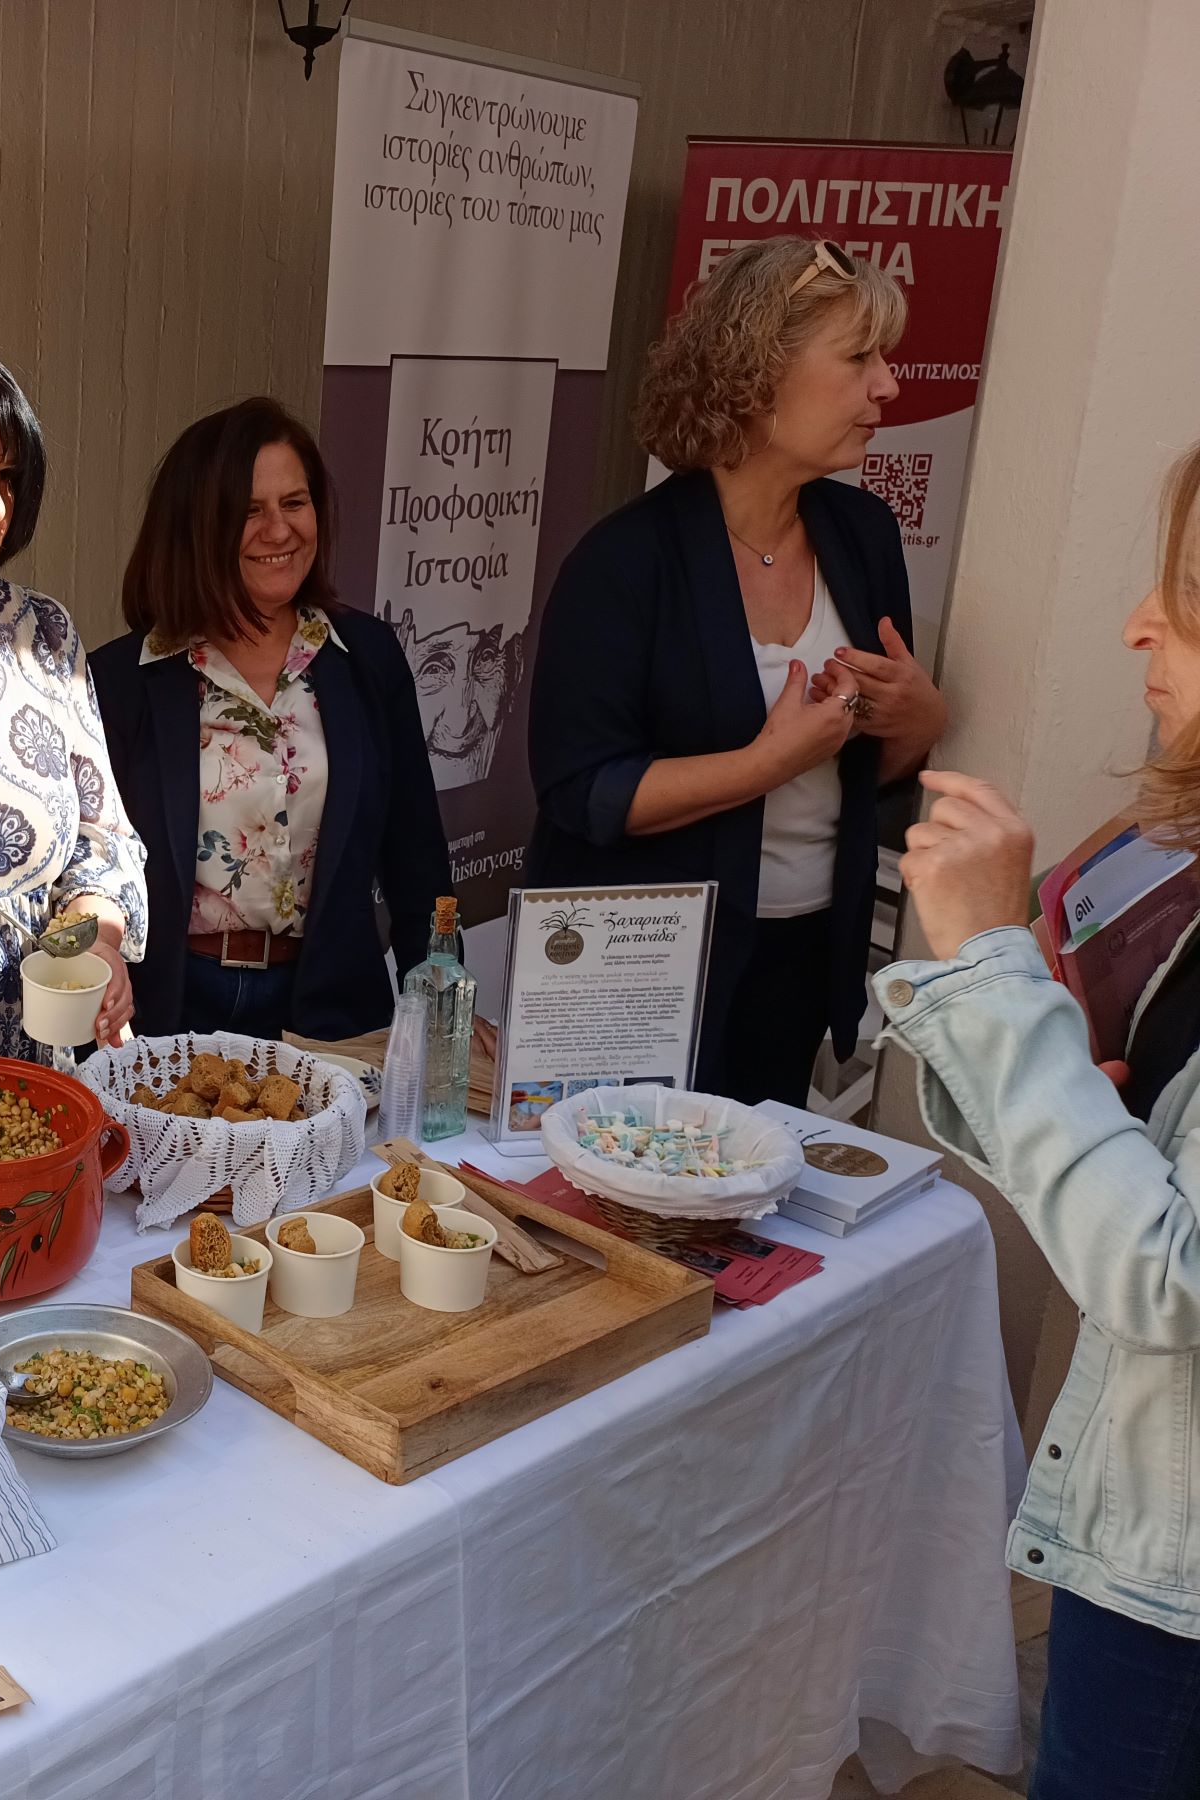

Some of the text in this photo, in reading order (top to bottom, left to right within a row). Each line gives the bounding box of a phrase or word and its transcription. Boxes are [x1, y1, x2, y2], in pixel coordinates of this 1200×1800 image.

[404, 70, 587, 149] Συγκεντρώνουμε
[382, 131, 596, 197] ιστορίες ανθρώπων,
[364, 178, 605, 245] ιστορίες του τόπου μας
[705, 177, 1009, 229] ΠΟΛΙΤΙΣΤΙΚΗ
[889, 363, 981, 381] ΟΛΙΤΙΣΜΟΣ
[419, 416, 512, 468] Κρήτη
[386, 477, 539, 535] Προφορική
[901, 533, 940, 548] itis.gr
[404, 543, 509, 592] Ιστορία
[449, 846, 526, 884] history.org
